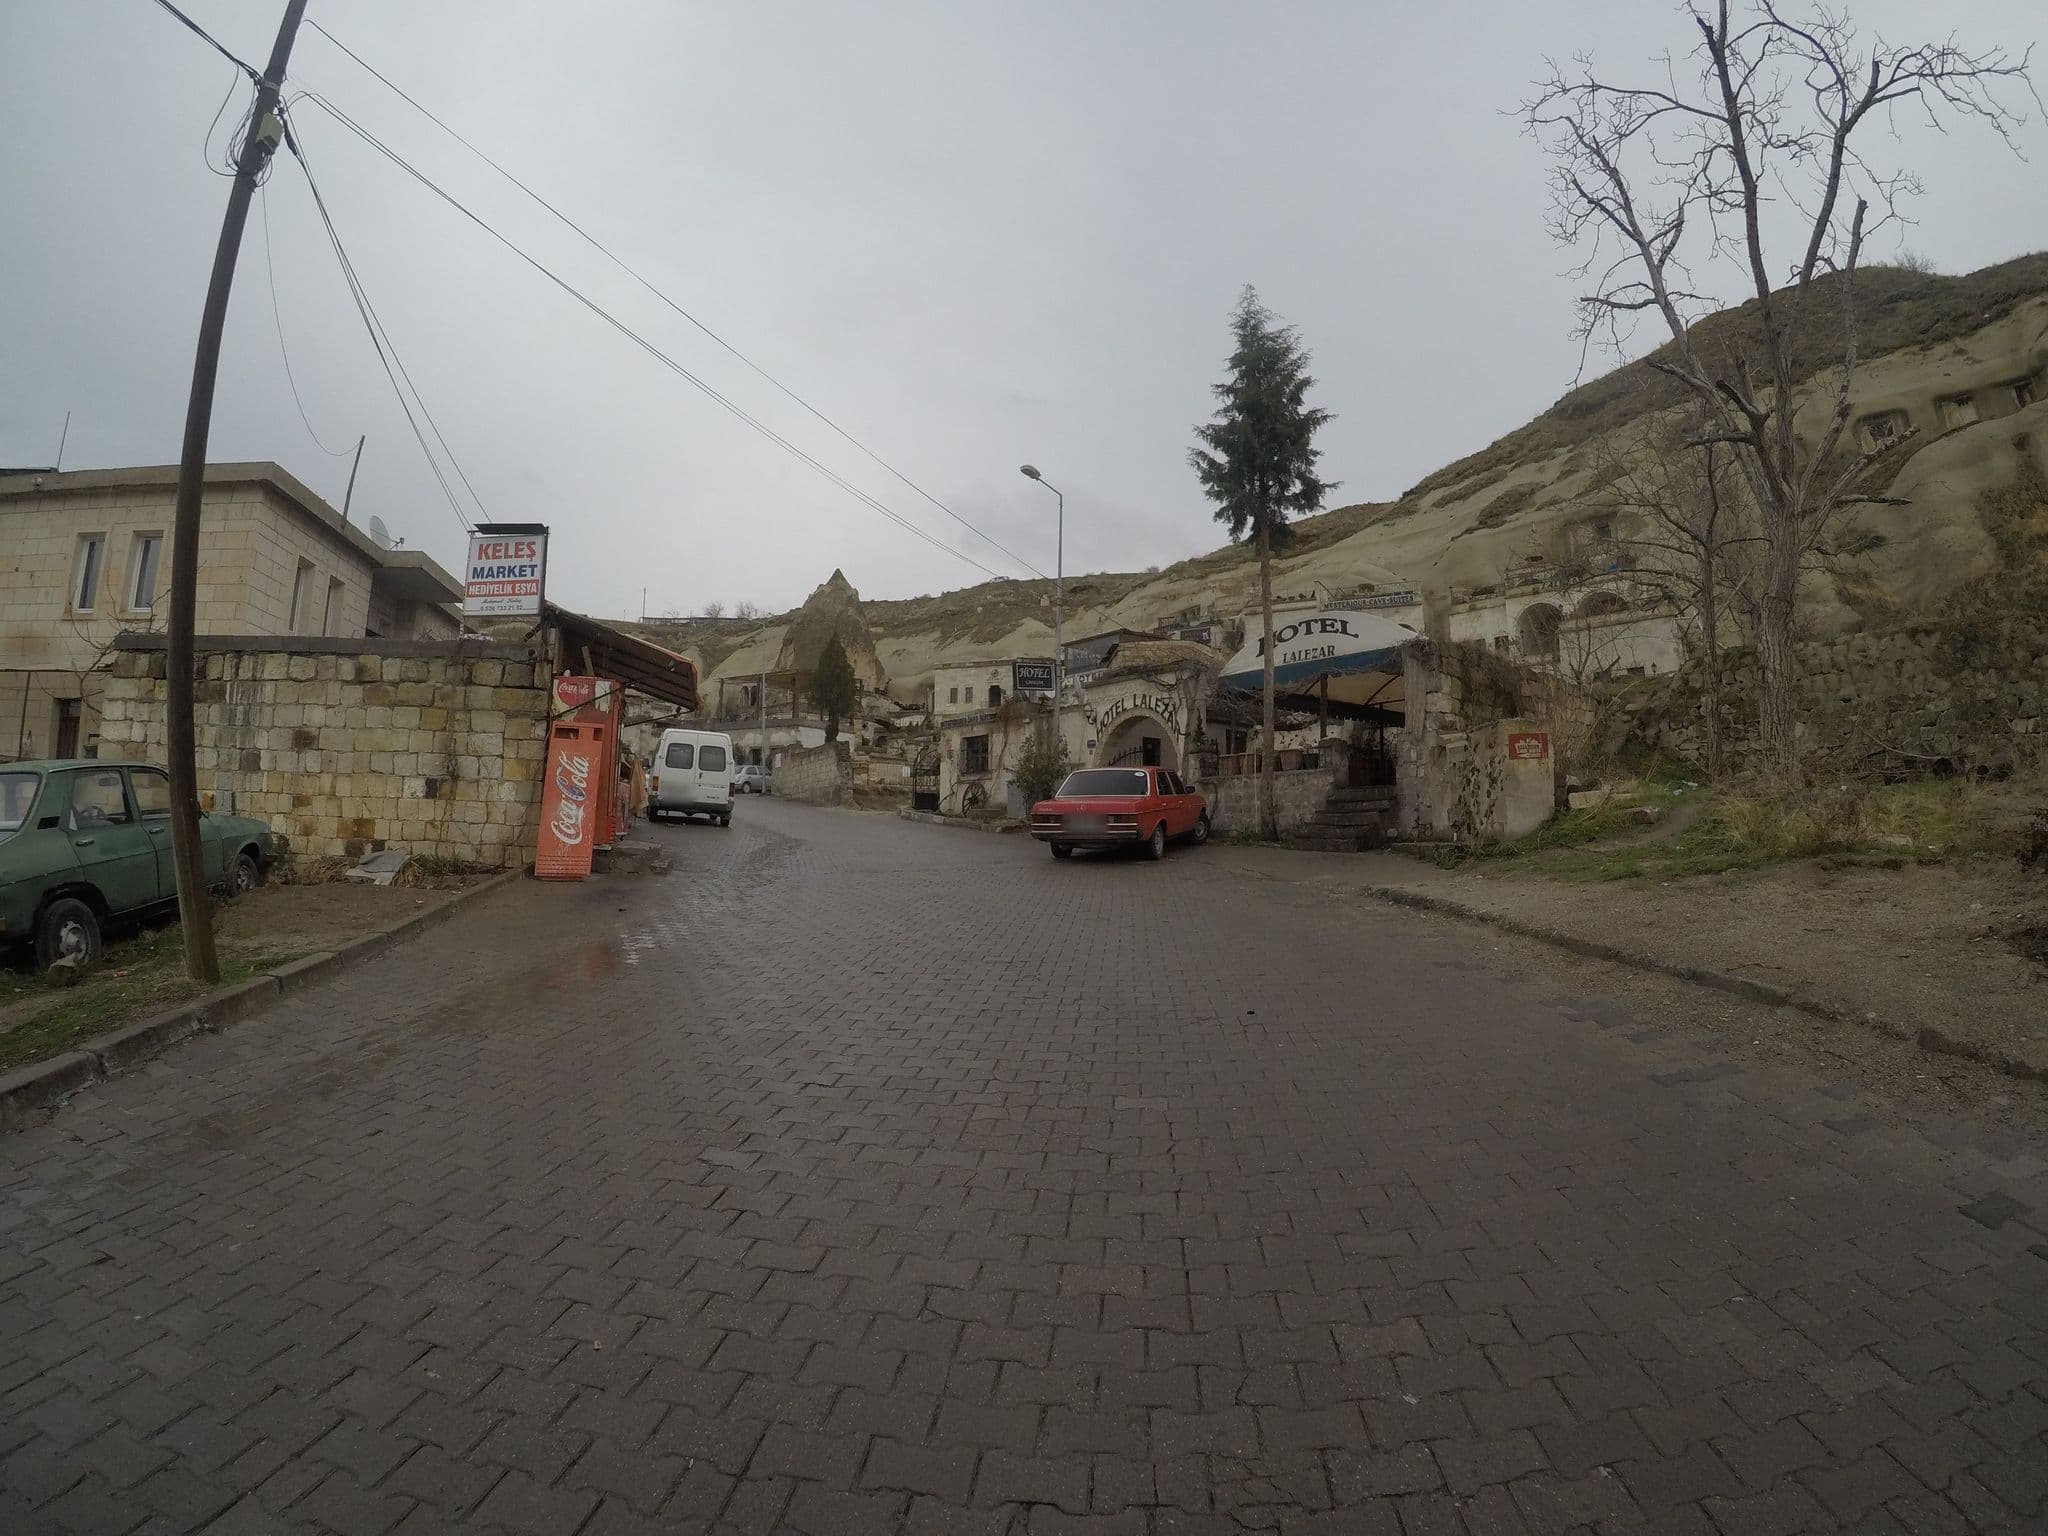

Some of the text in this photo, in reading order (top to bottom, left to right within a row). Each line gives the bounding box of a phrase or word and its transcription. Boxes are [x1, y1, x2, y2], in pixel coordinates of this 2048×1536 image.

[478, 541, 536, 562] KELEŞ
[472, 565, 538, 579] MARKET
[468, 582, 537, 595] HEDİYELİK EŞYA
[1283, 645, 1336, 664] LALEZAR
[1018, 667, 1050, 678] HOTEL
[1096, 698, 1127, 742] HOTEL
